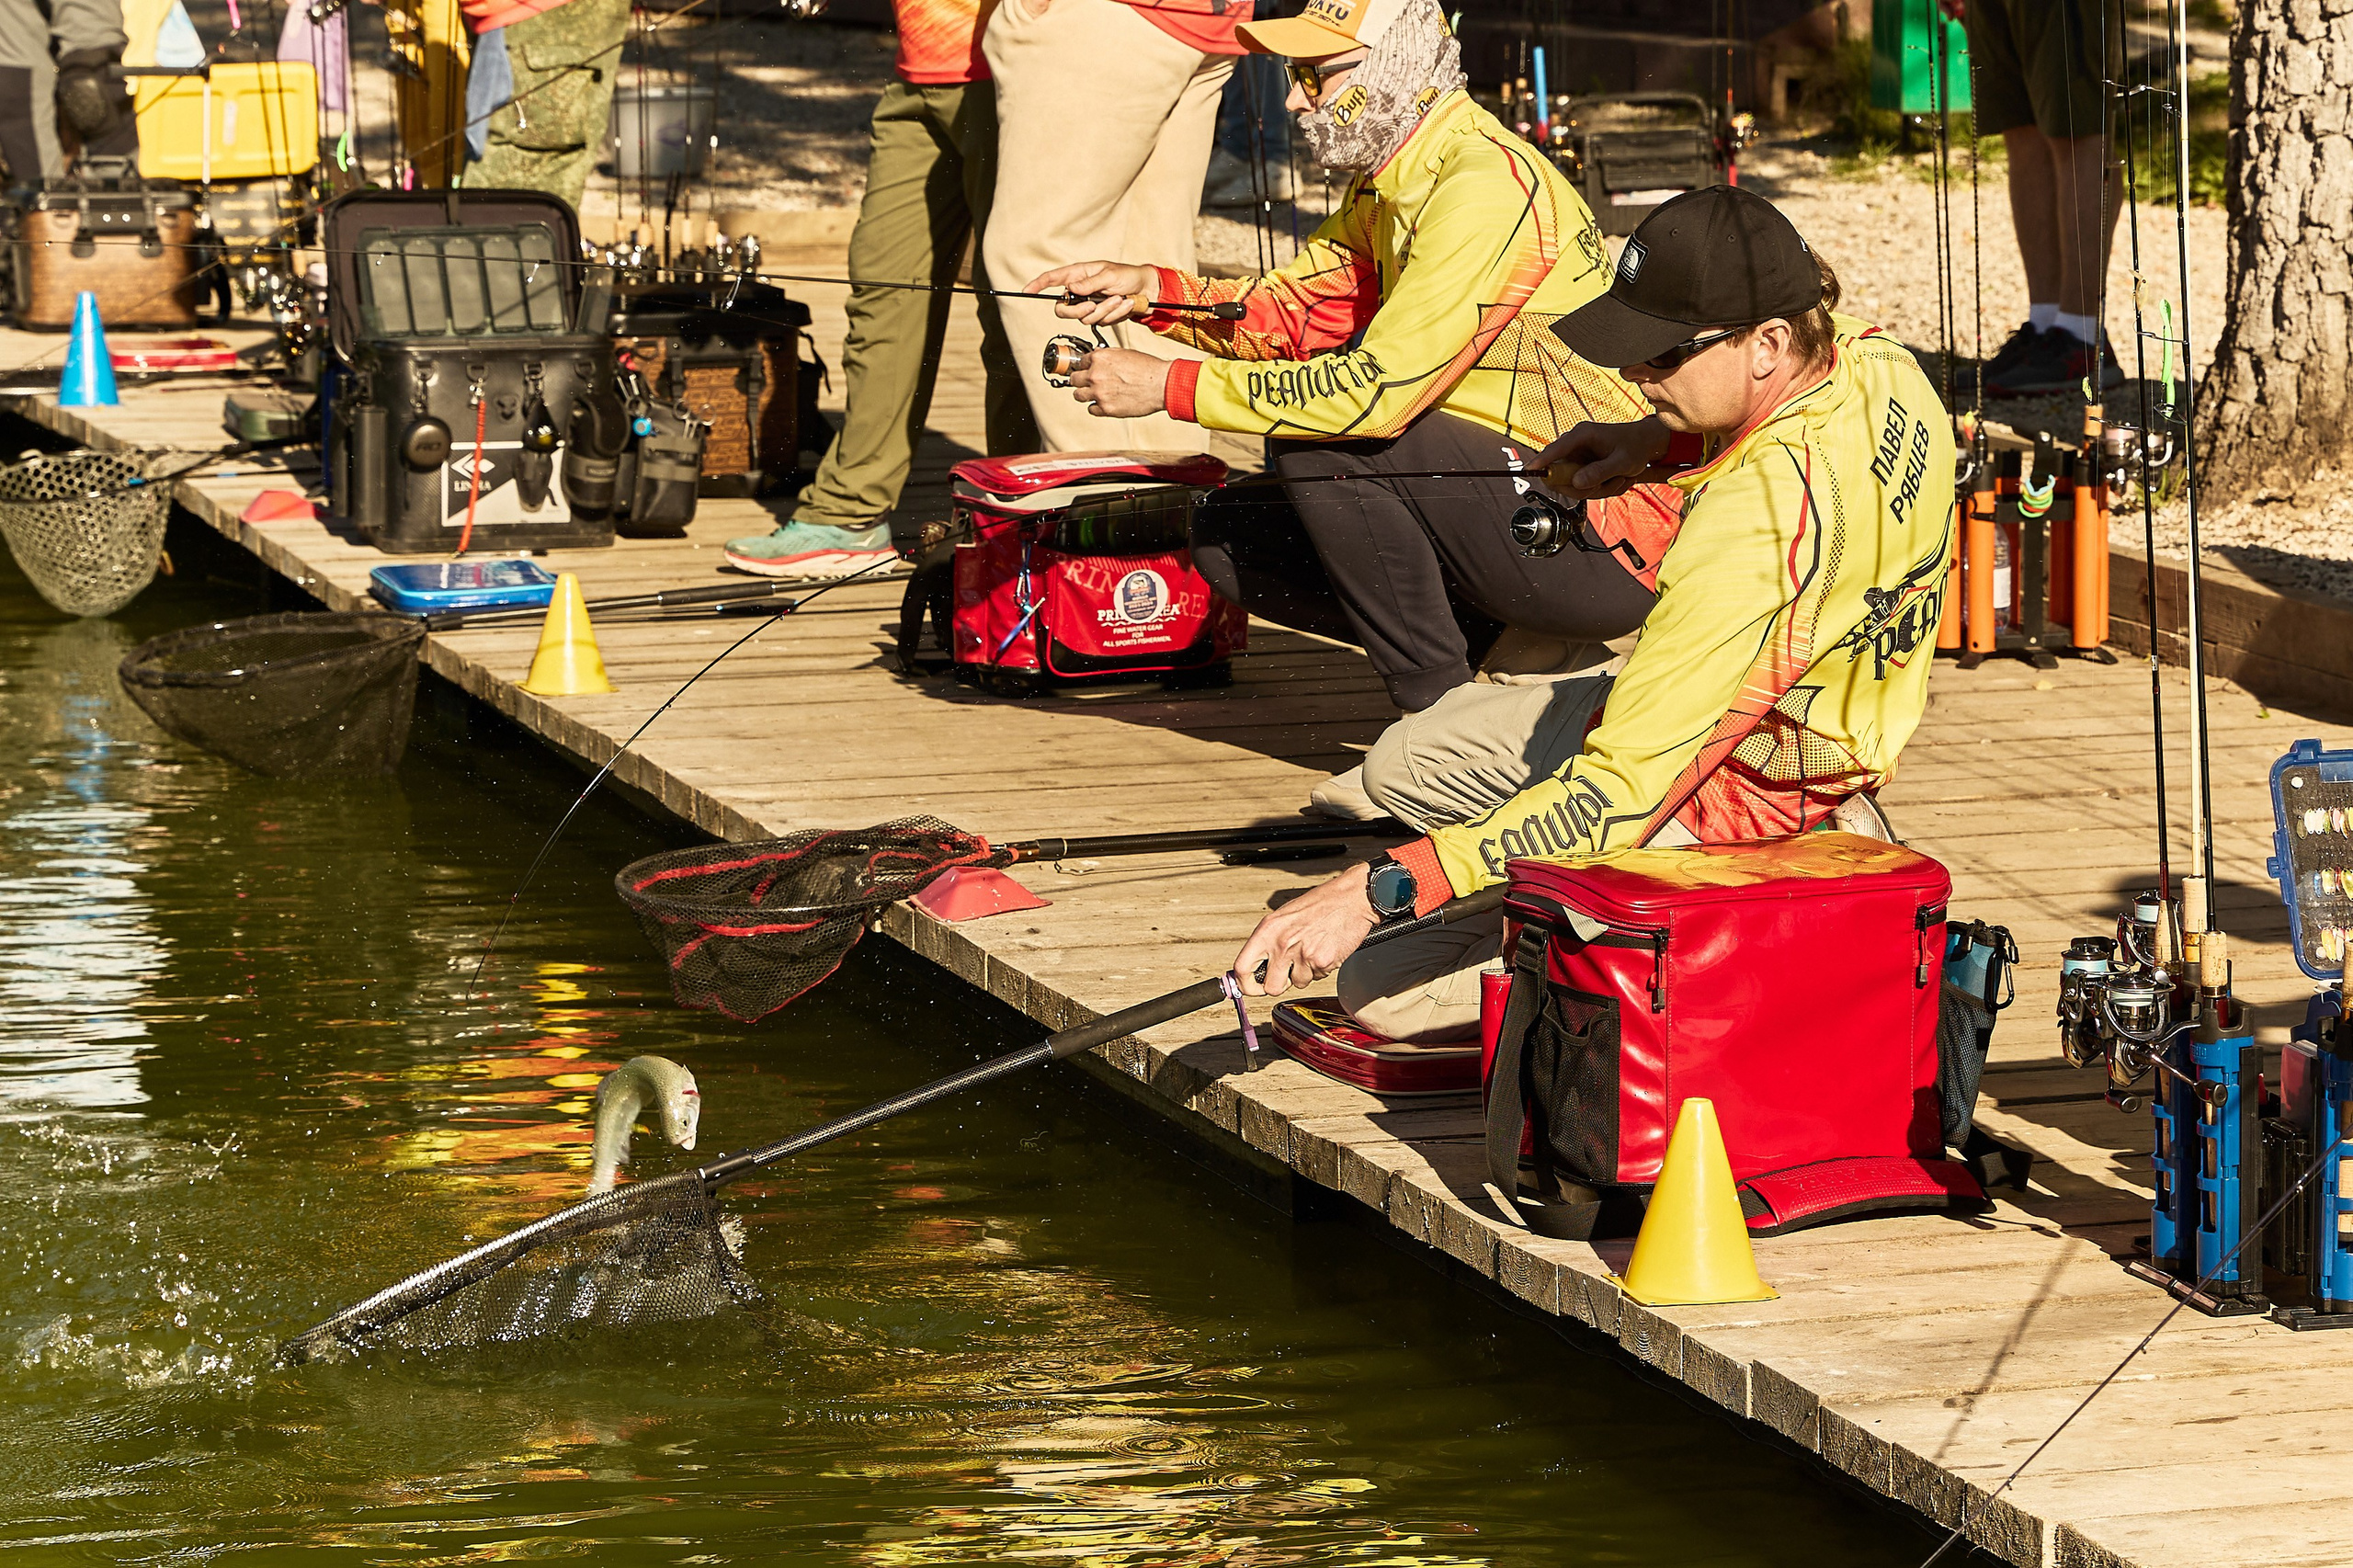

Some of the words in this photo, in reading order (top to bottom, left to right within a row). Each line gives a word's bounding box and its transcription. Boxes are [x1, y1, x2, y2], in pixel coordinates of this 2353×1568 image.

[1870, 396, 1907, 486] ПАВЕЛ
[1889, 420, 1929, 525] РЯБЦЕВ
[1115, 639, 1137, 647] SPORTS
[1127, 625, 1147, 633] WATER
